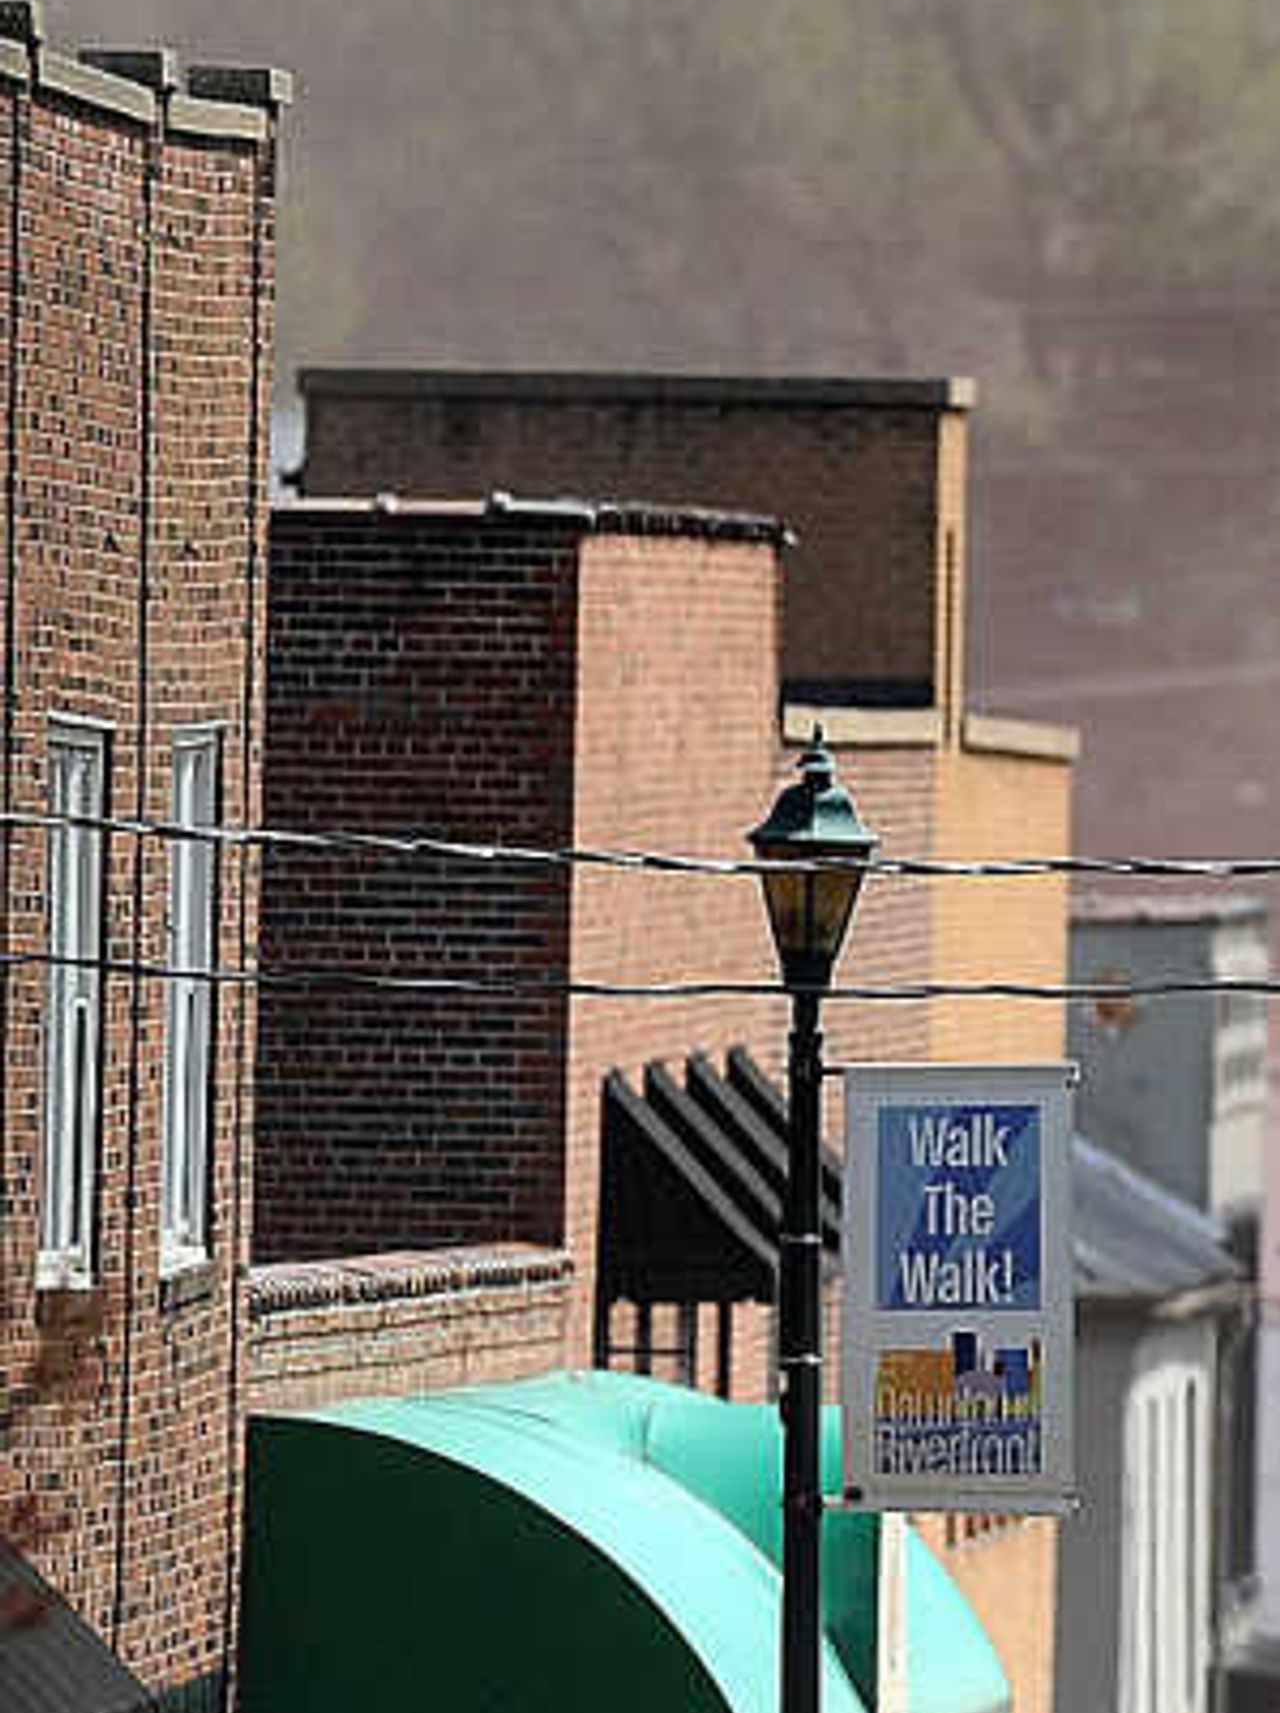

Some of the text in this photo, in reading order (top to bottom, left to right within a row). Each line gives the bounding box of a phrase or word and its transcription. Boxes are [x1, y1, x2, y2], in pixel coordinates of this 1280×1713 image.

[908, 1115, 1009, 1167] Walk
[924, 1182, 995, 1235] The
[900, 1249, 1013, 1305] Walk!
